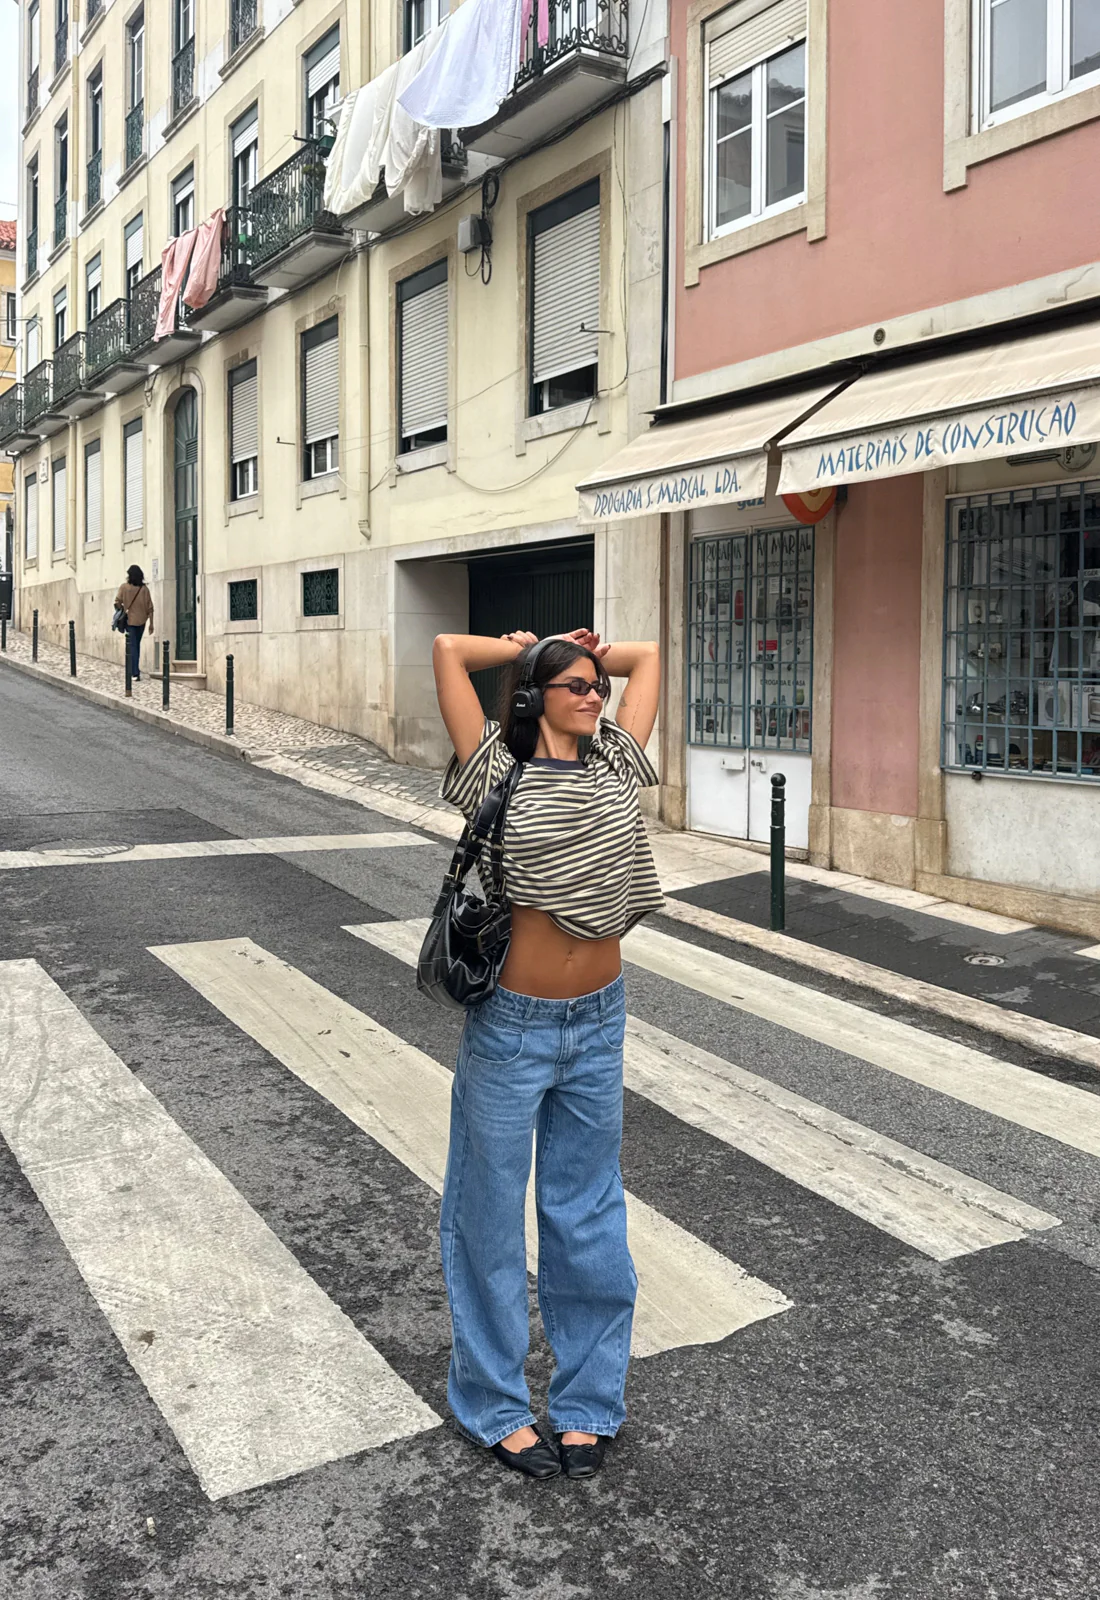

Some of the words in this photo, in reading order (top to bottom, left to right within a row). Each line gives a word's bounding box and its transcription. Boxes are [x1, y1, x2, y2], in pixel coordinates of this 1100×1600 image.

[816, 433, 908, 479] MATERIAIS
[914, 428, 935, 460] DE
[942, 400, 1077, 454] CONSTRUÇÃO
[593, 486, 642, 518] DROGARIA
[645, 483, 654, 508] S.
[715, 468, 742, 494] LDA.
[771, 533, 811, 555] MARAL
